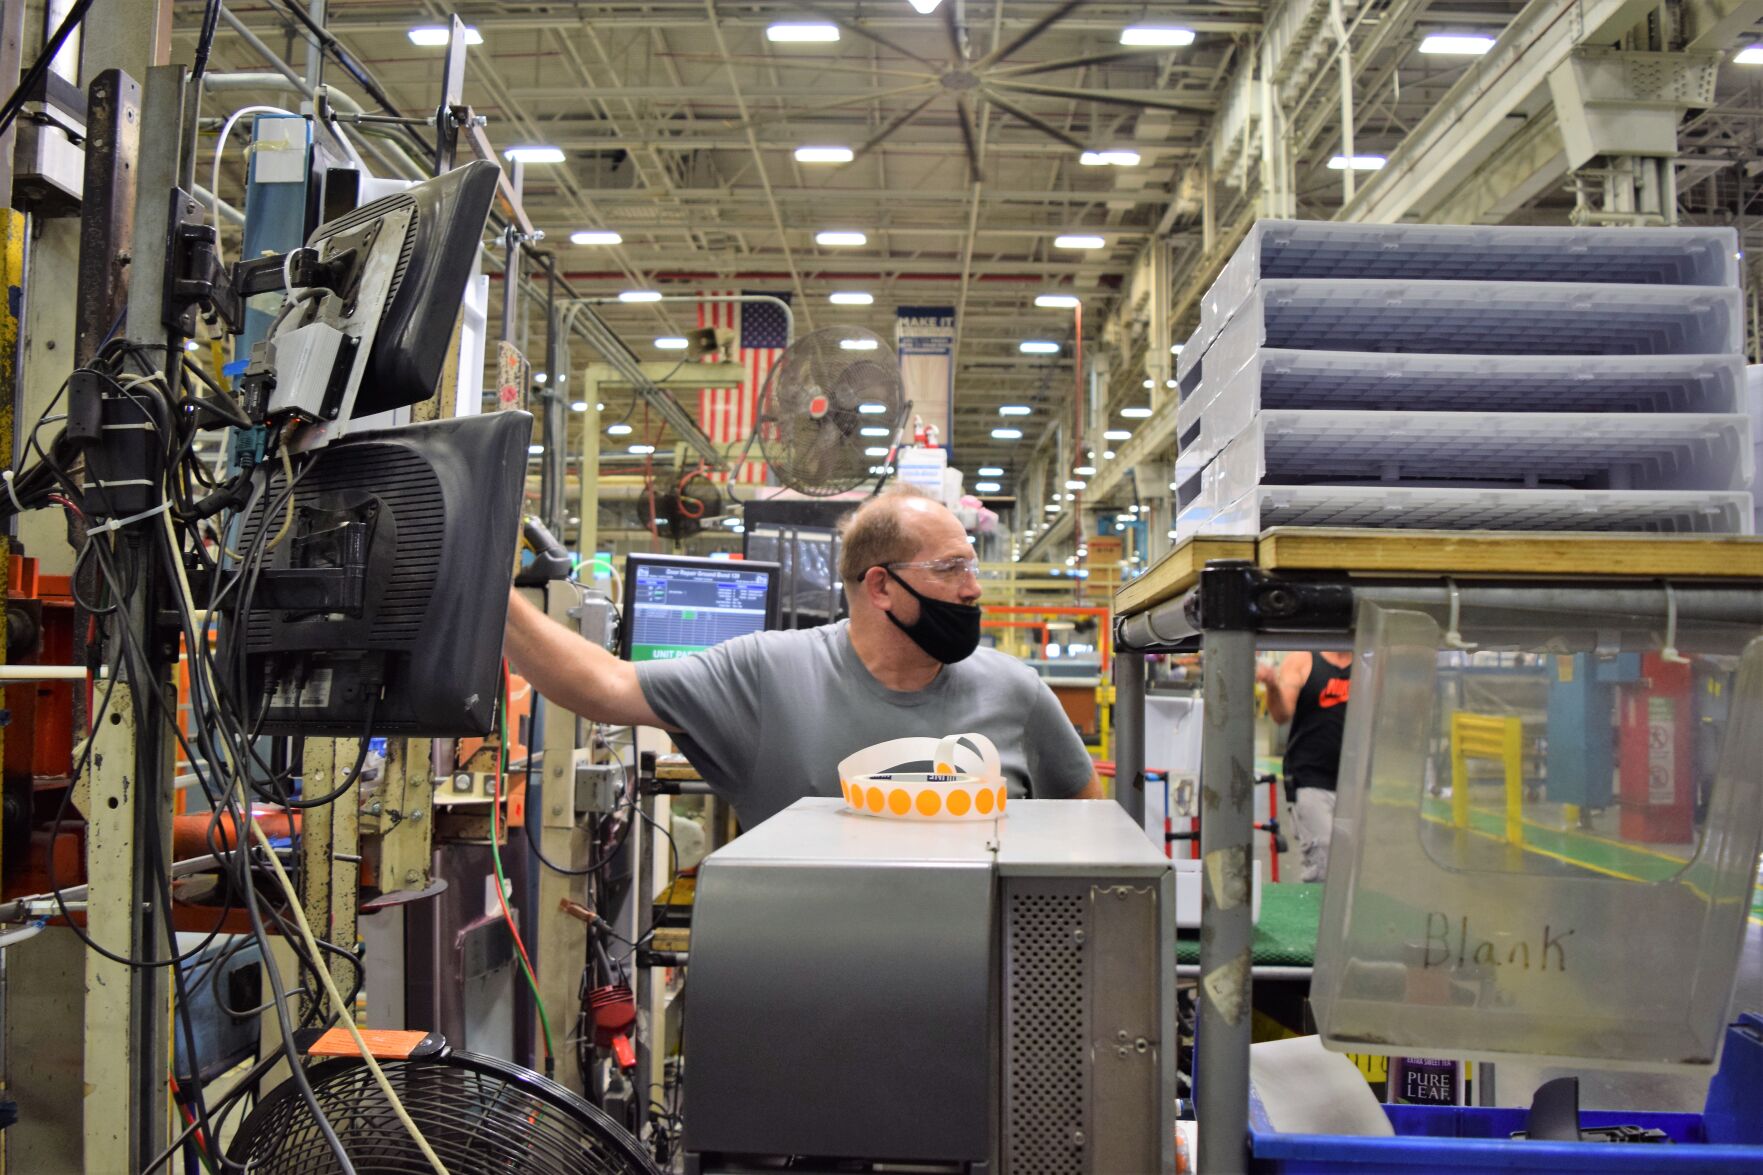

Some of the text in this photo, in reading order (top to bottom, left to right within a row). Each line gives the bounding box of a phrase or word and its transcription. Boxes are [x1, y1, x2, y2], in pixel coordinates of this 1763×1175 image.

[899, 317, 954, 328] MAKE IT
[653, 649, 673, 659] UNIT
[1408, 1071, 1451, 1088] PURE
